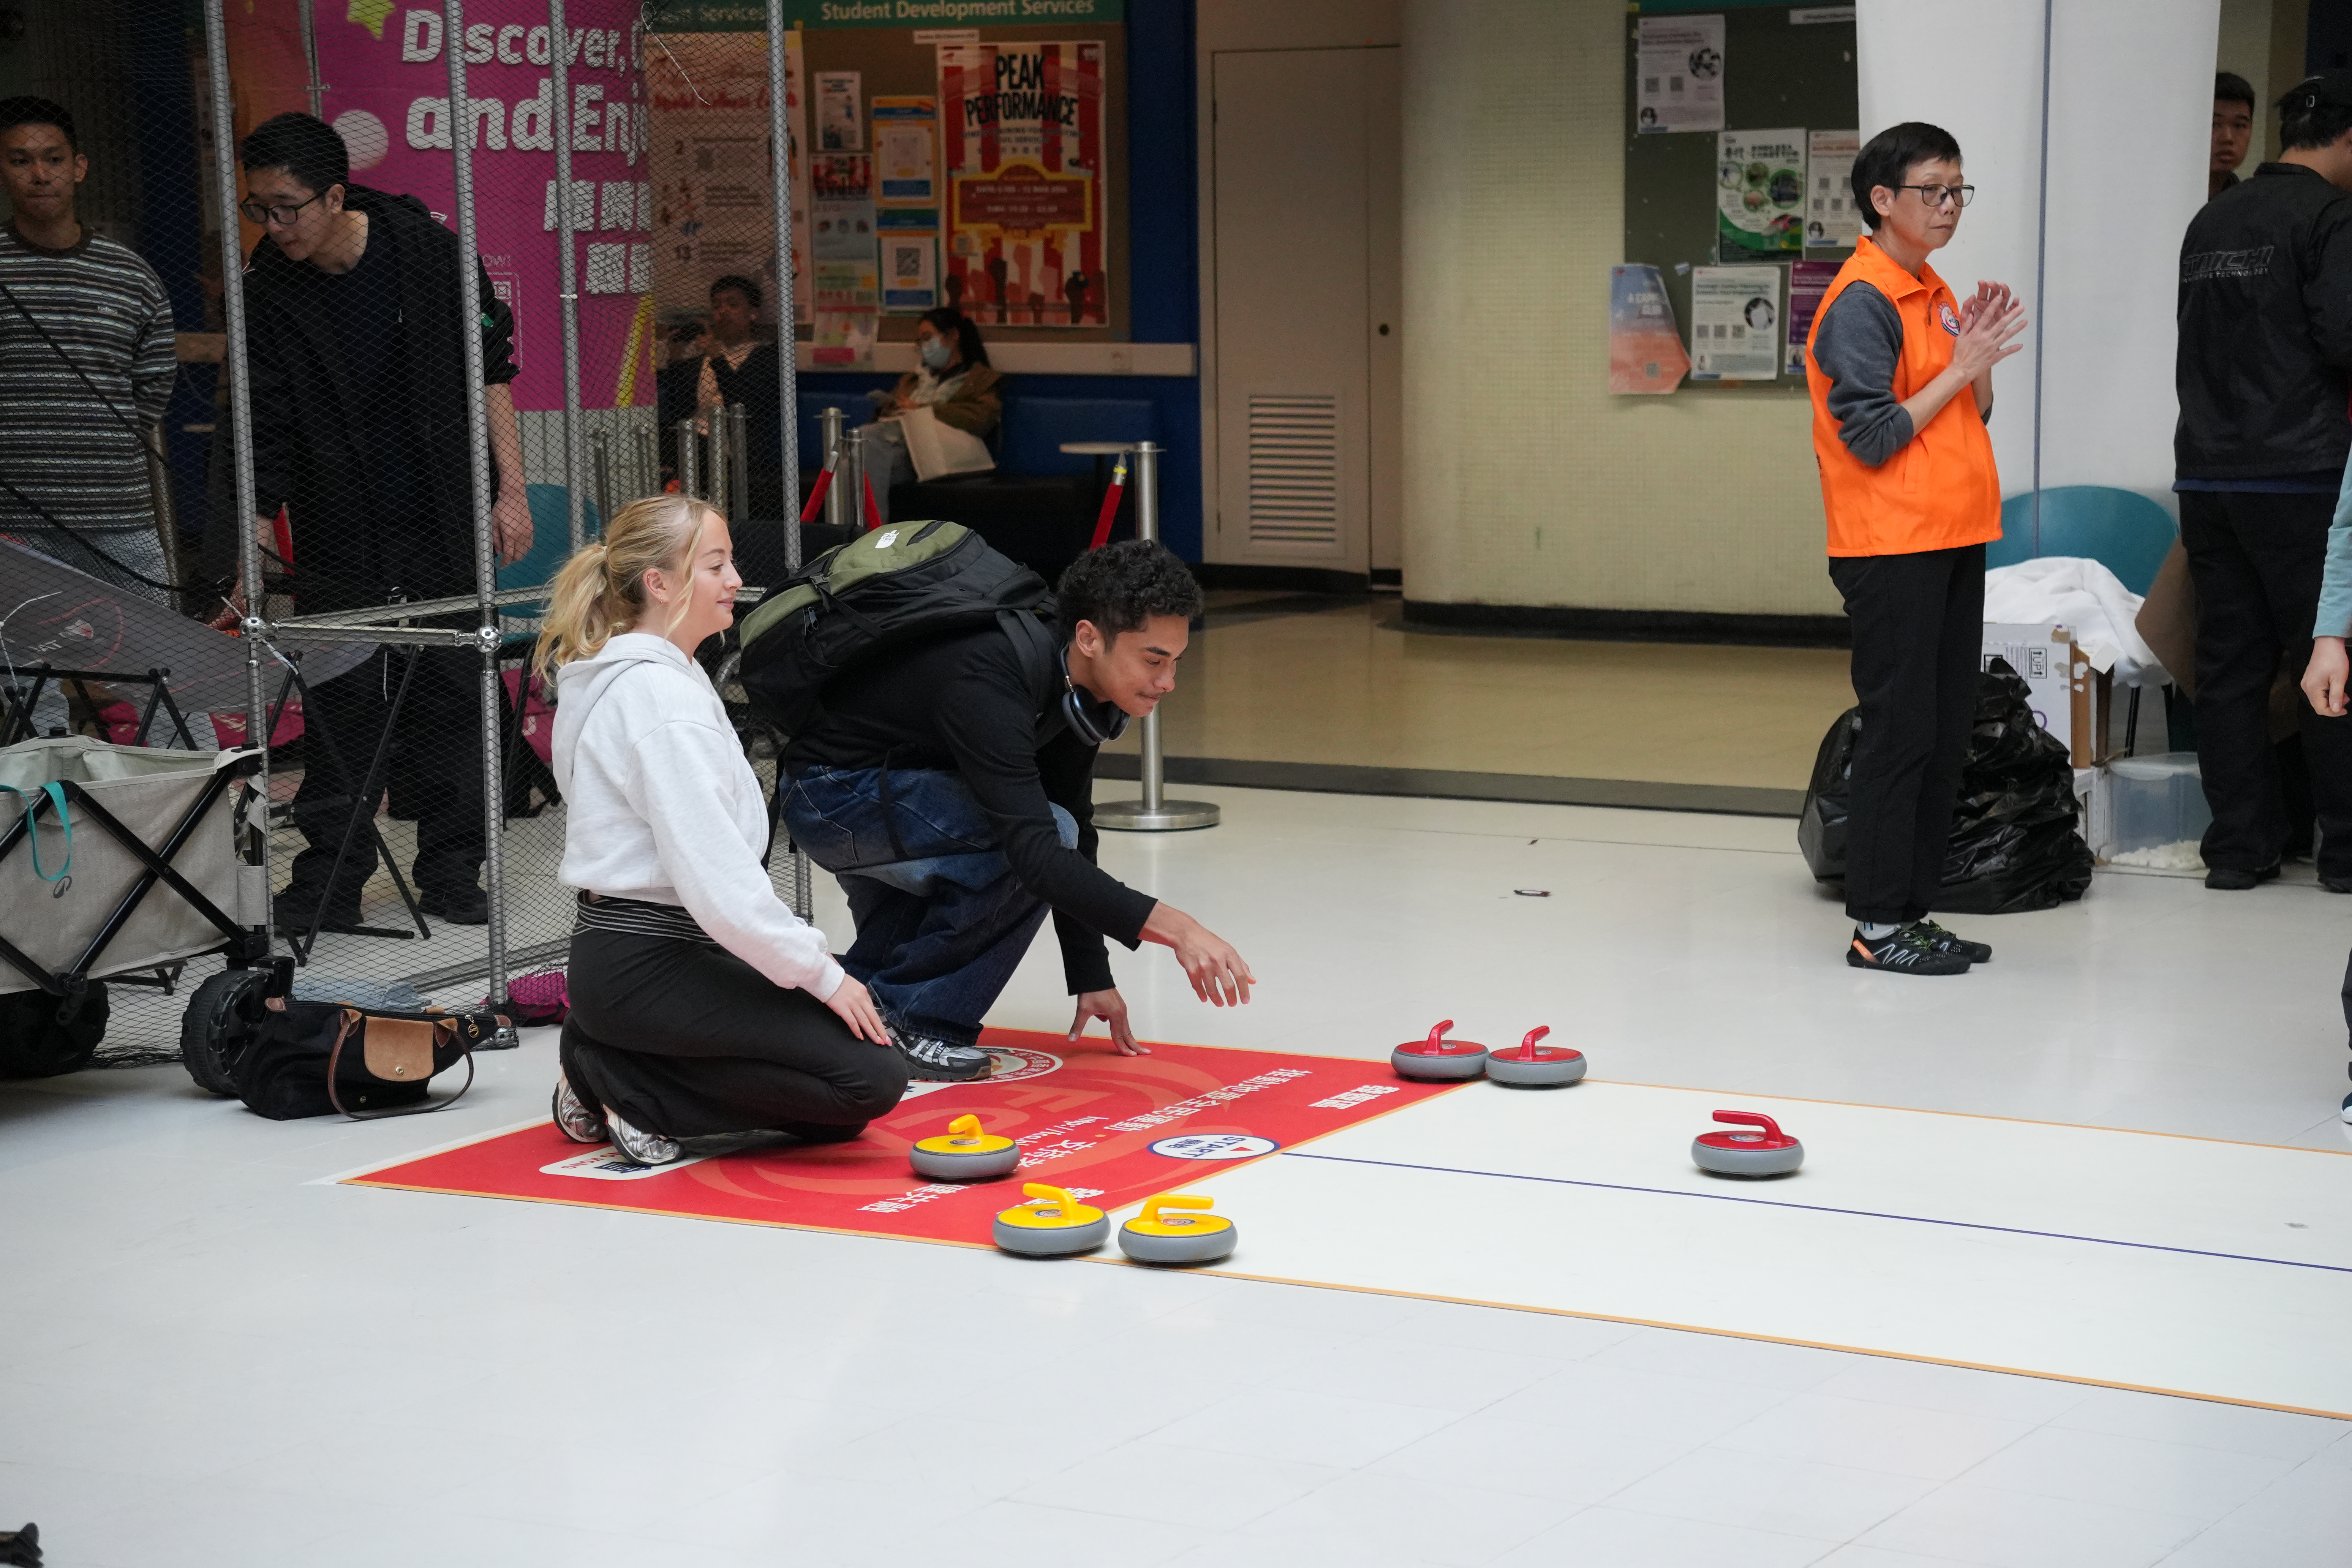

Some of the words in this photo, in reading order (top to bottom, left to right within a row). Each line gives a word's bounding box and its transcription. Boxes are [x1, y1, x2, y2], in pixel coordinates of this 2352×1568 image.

[821, 2, 891, 21] Student
[896, 0, 1015, 22] Development
[1022, 0, 1095, 16] Services
[403, 9, 626, 77] Dscover,
[995, 54, 1046, 91] PEAK
[964, 92, 1078, 126] PERFORMANCE
[2033, 657, 2042, 671] UP
[1165, 1139, 1208, 1150] 開始
[1180, 1136, 1242, 1159] START
[561, 1158, 600, 1170] KONG
[857, 1140, 1098, 1213] 支持老健共融
